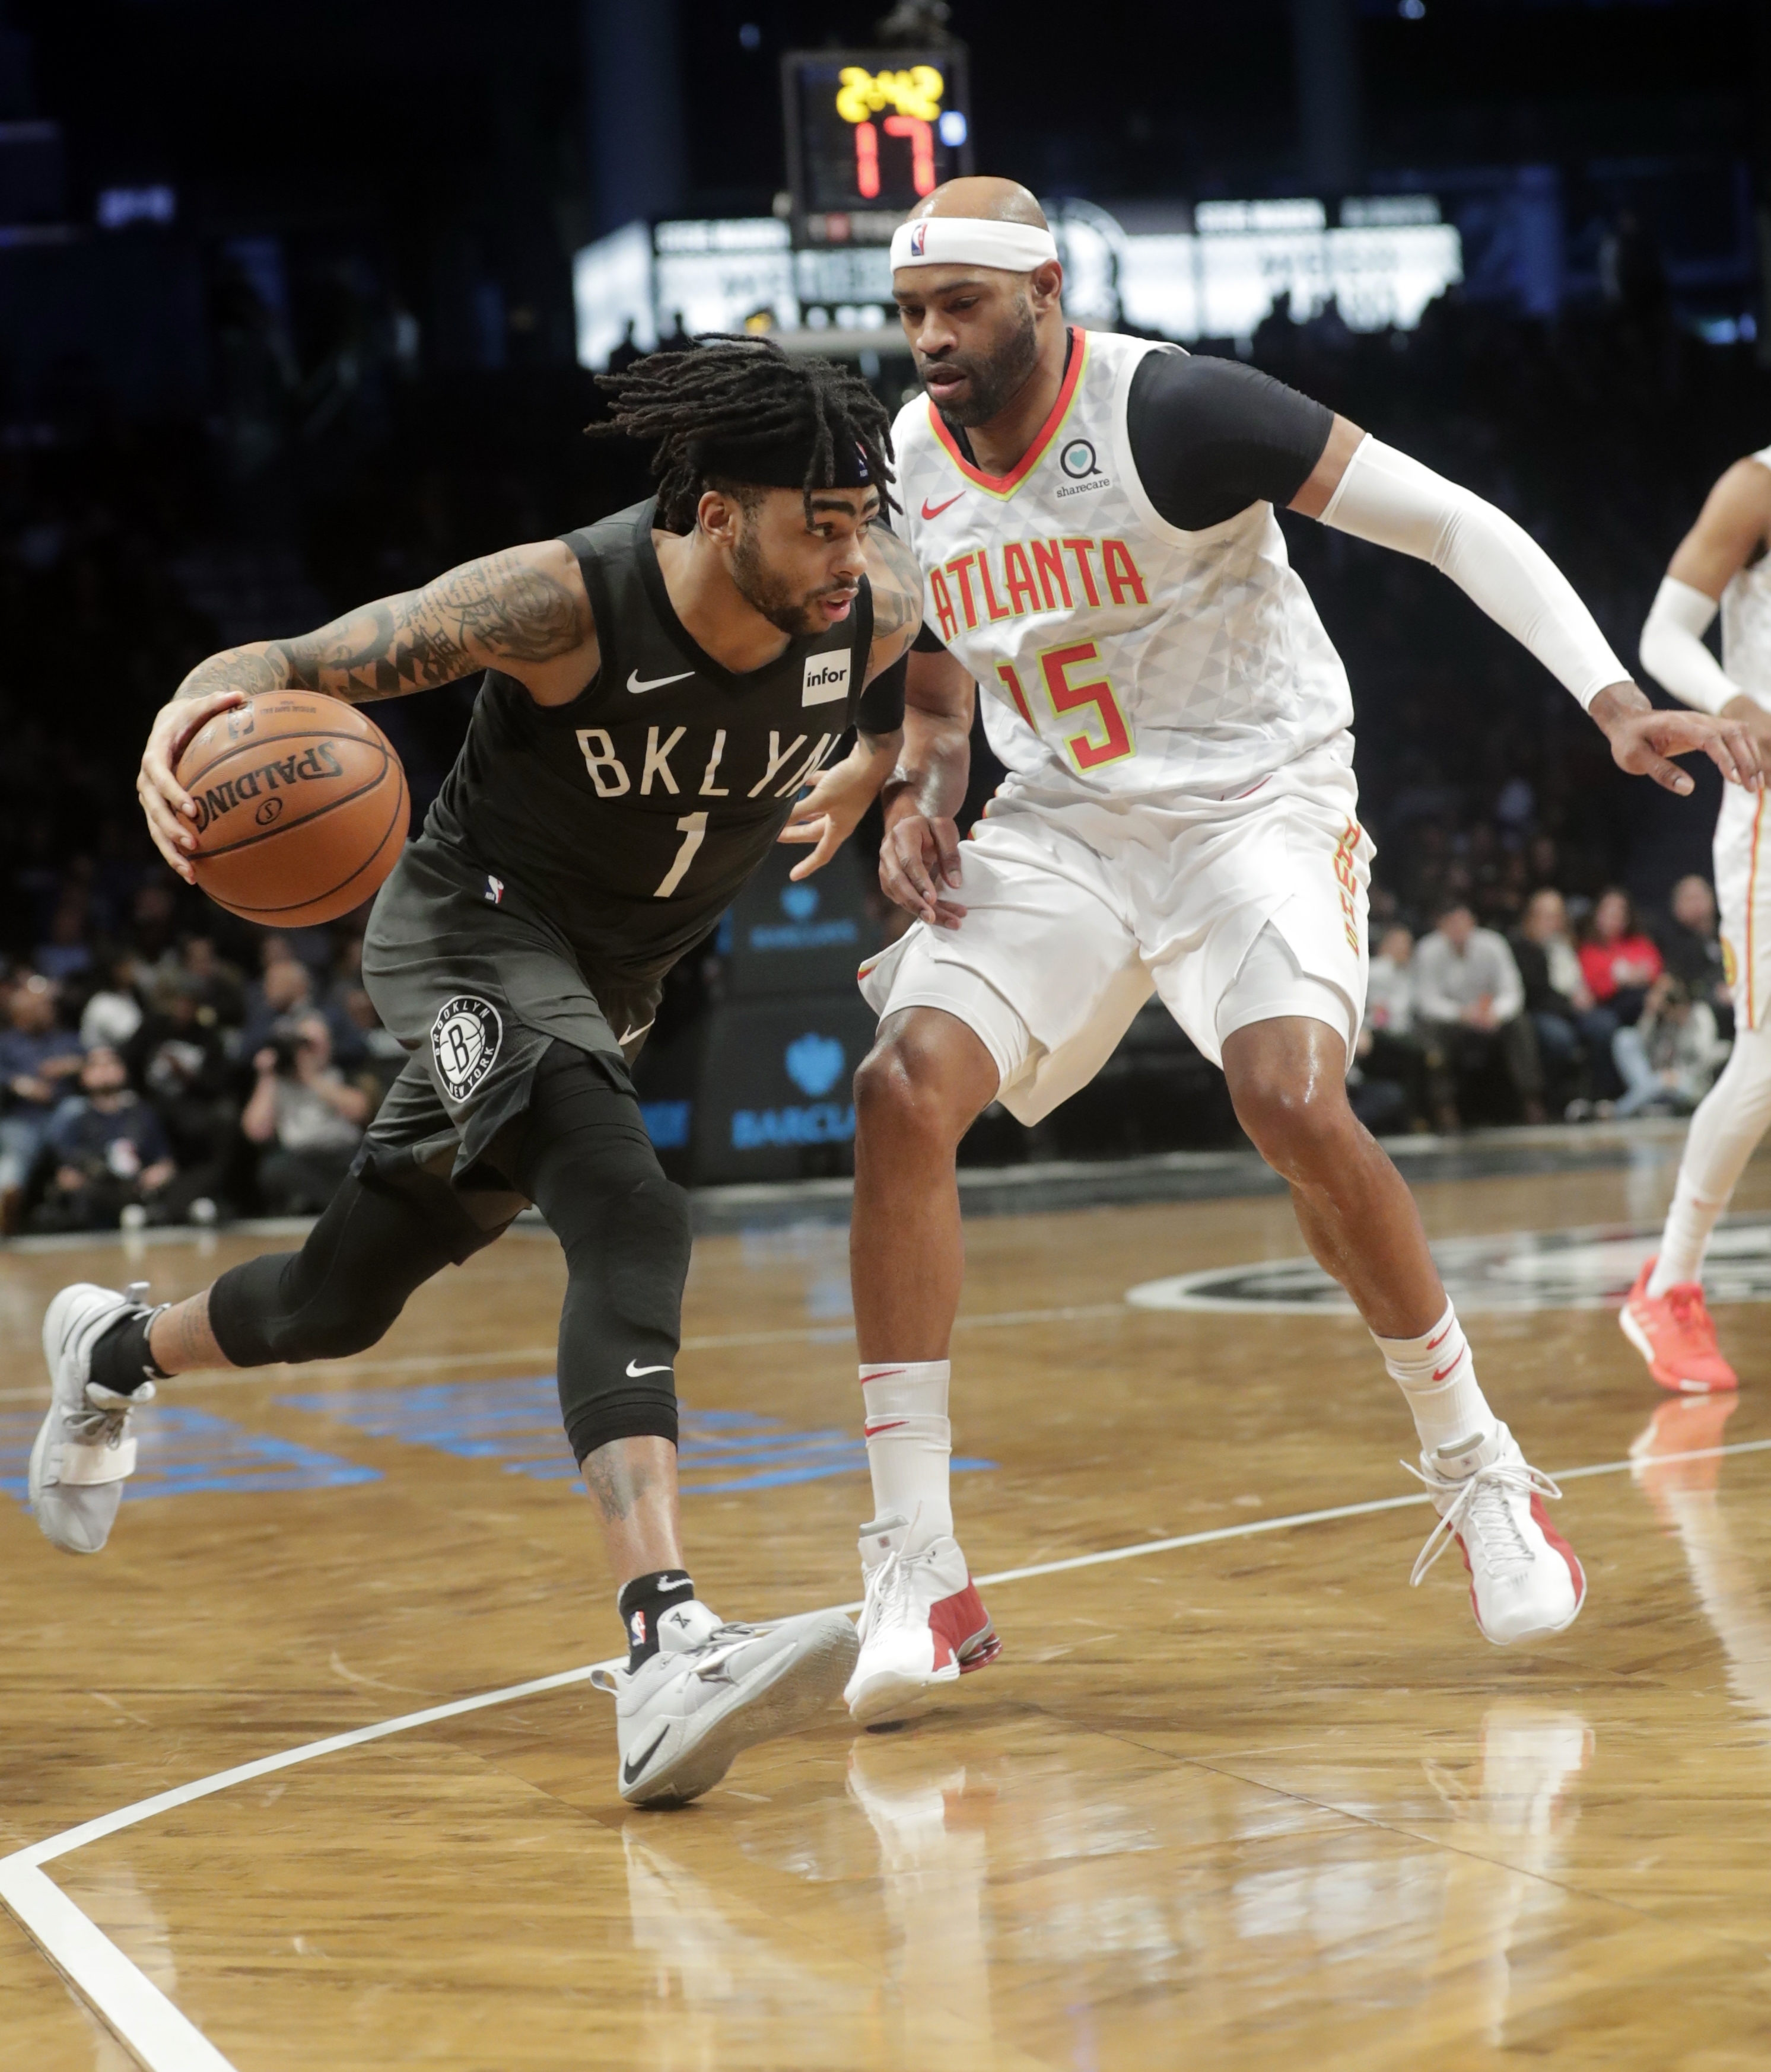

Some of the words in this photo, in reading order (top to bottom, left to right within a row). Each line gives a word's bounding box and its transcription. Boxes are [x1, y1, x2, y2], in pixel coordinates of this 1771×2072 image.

[856, 116, 936, 198] 17
[1057, 479, 1110, 498] sharecare
[929, 537, 1150, 644] ATLANTA
[806, 667, 847, 688] infor
[994, 637, 1137, 776] 15
[576, 727, 841, 798] BKLYN
[653, 811, 709, 897] 1
[449, 1082, 465, 1097] NEW
[468, 1046, 495, 1087] YORK
